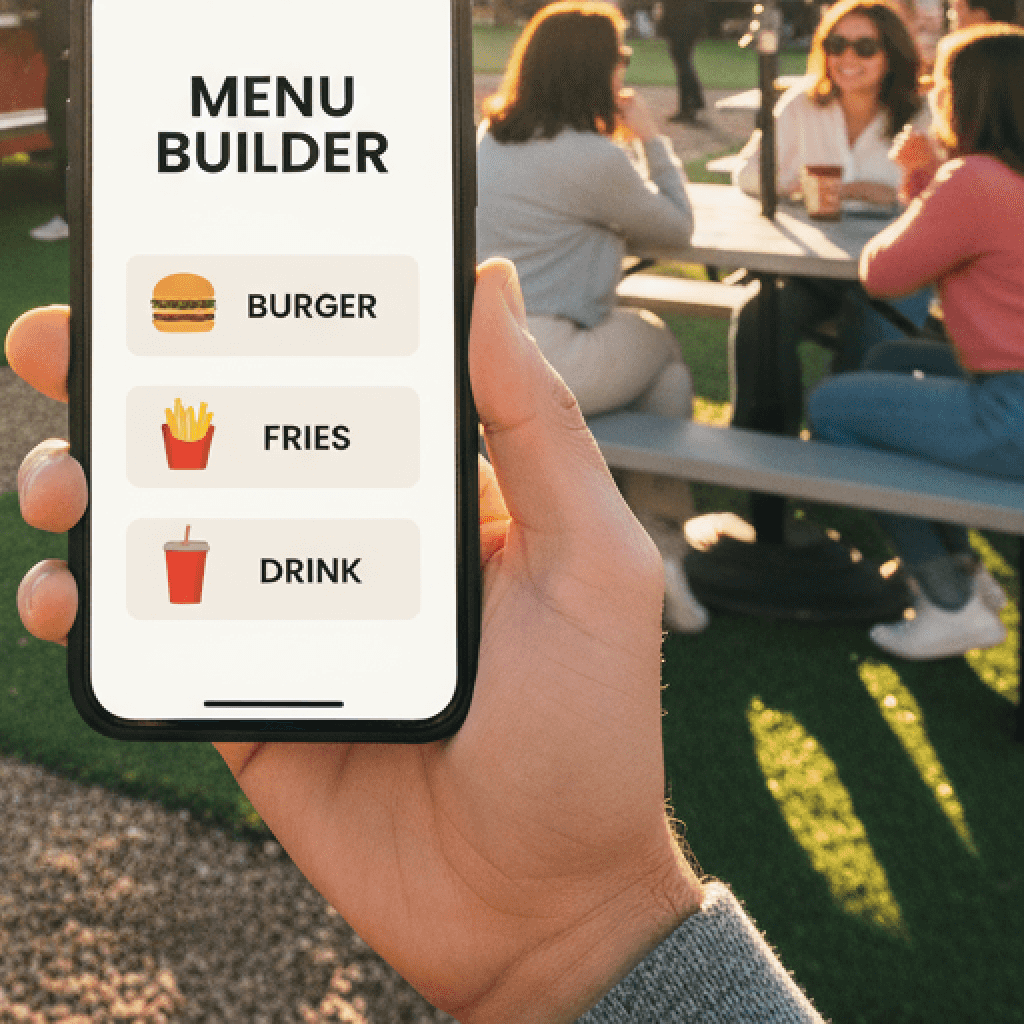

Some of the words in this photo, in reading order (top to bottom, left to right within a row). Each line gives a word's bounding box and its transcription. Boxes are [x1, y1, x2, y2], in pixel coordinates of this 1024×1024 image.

[190, 75, 355, 117] MENU
[157, 131, 389, 173] BUILDER
[247, 292, 377, 320] BURGER
[264, 424, 351, 451] FRIES
[260, 557, 361, 584] DRINK
